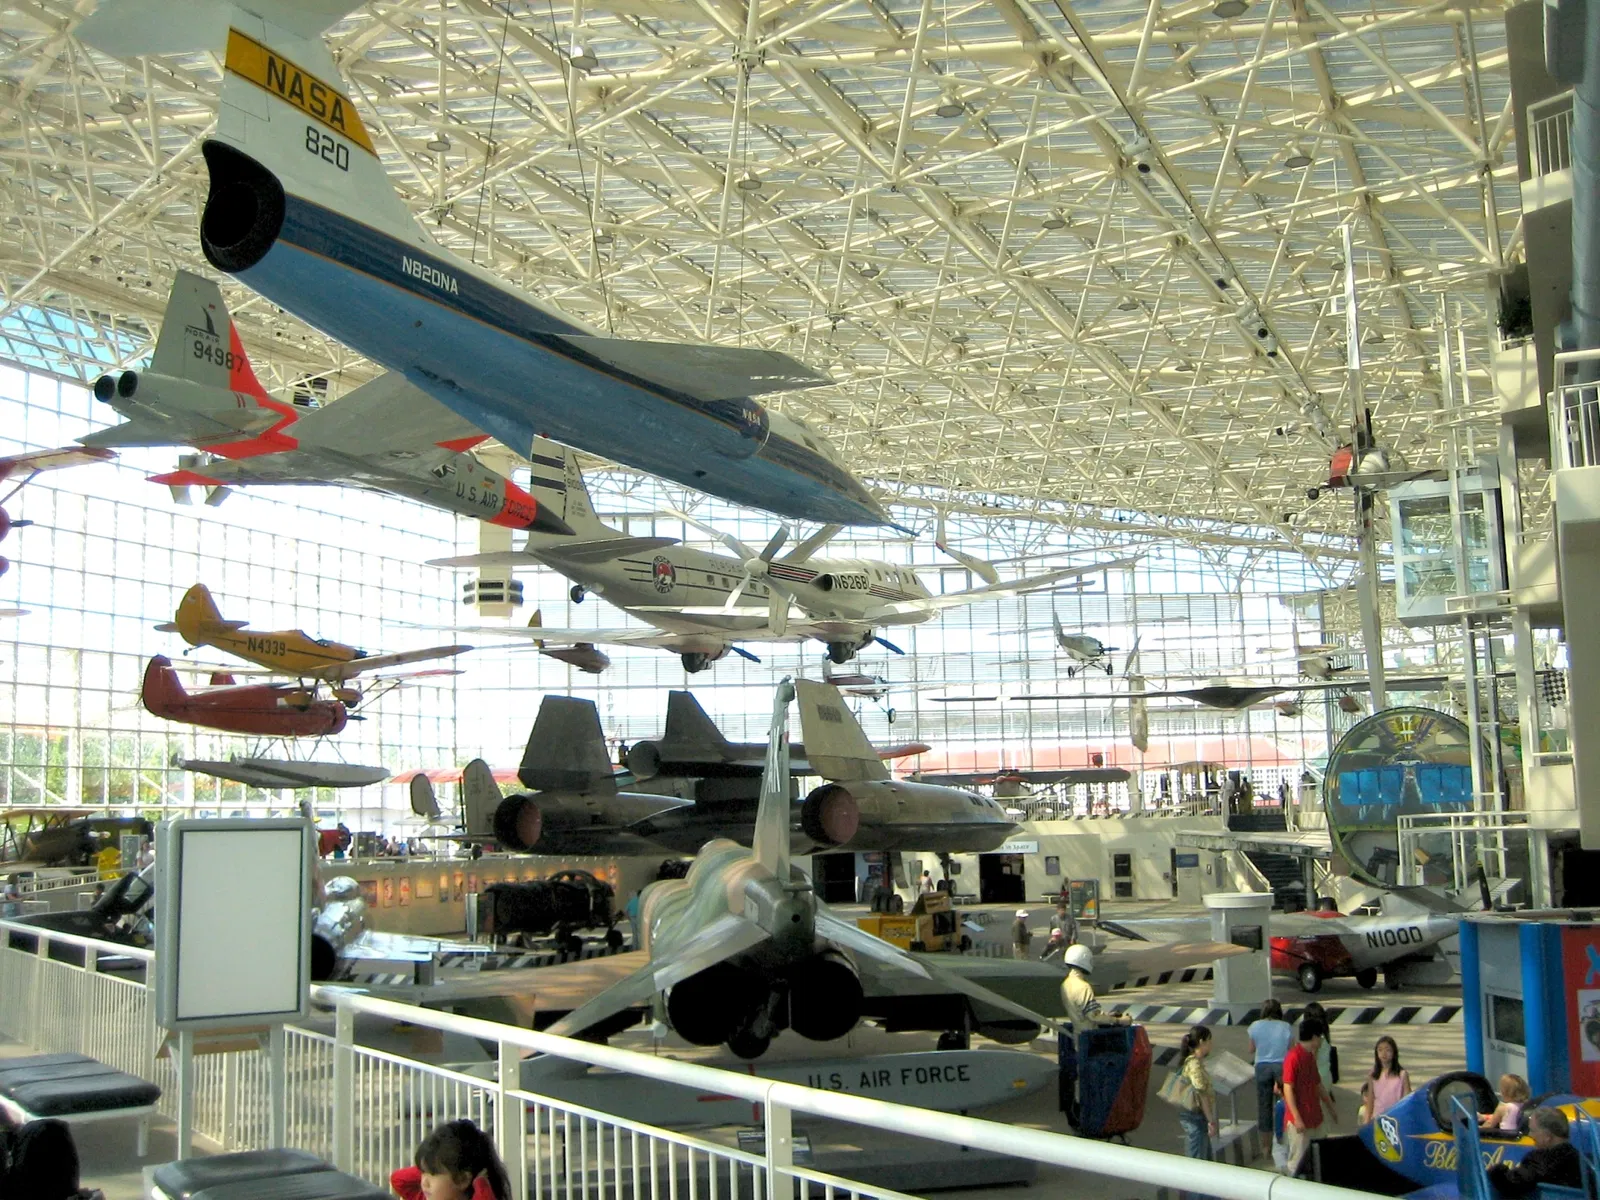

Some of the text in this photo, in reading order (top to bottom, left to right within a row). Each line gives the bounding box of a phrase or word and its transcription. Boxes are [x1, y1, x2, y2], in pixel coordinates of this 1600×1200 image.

[266, 55, 347, 132] NASA
[305, 125, 350, 172] 820
[402, 255, 459, 296] N820NA
[193, 340, 245, 374] 94987
[742, 408, 761, 427] NASA
[455, 481, 477, 504] U.S.
[479, 490, 499, 510] AIR
[499, 496, 535, 523] FORCE
[247, 636, 287, 657] N4339
[1366, 925, 1424, 950] N100D
[808, 1064, 970, 1091] U.S. AIR FORCE
